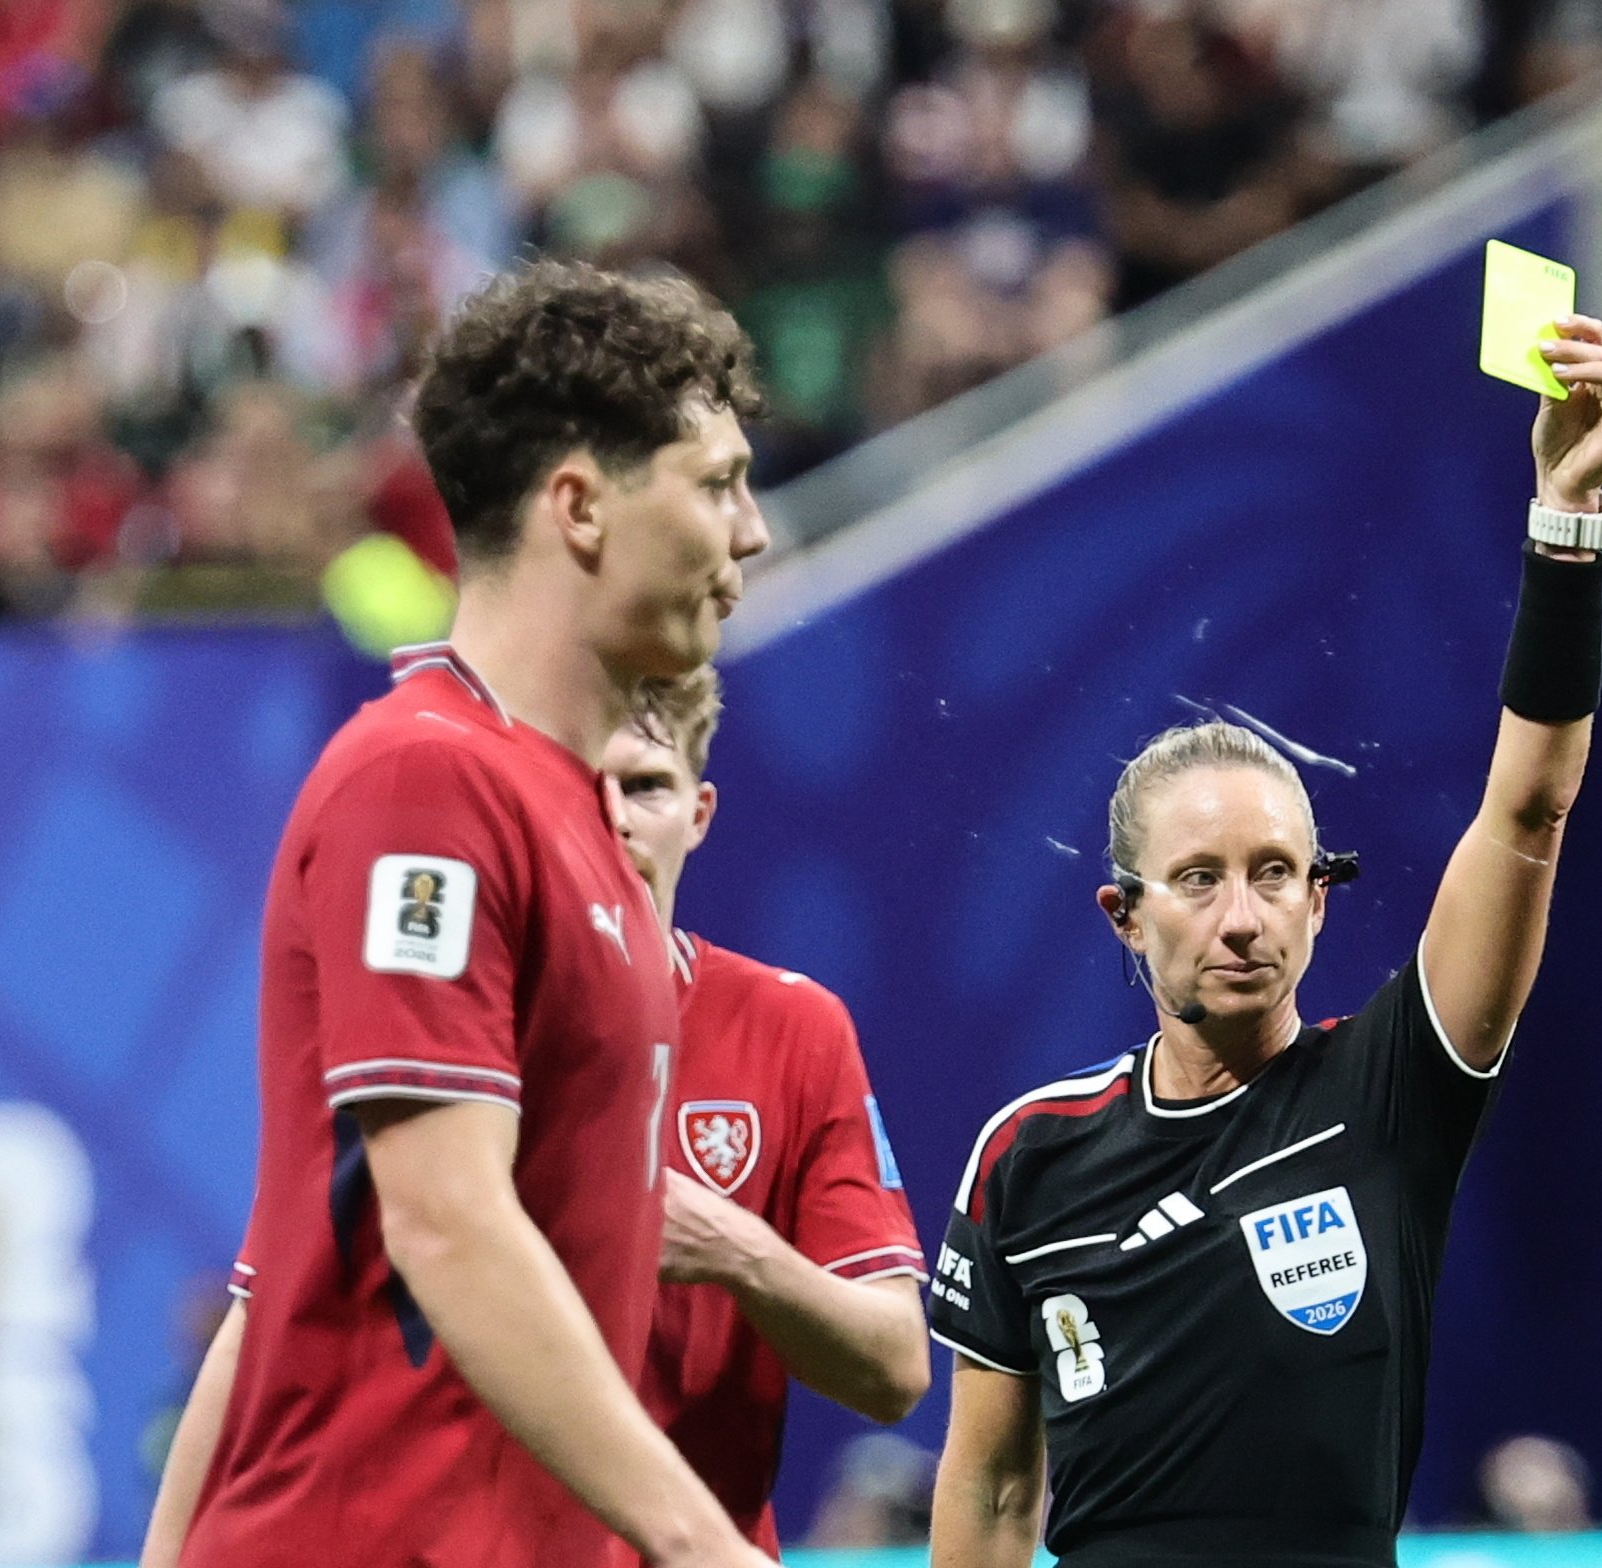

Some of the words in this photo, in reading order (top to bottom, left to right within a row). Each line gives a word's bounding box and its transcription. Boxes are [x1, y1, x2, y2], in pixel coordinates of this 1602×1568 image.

[1254, 1201, 1346, 1251] FIFA
[937, 1241, 972, 1290] IFA
[1270, 1250, 1357, 1288] REFEREE
[1305, 1300, 1347, 1325] 2026
[1073, 1375, 1093, 1390] FIFA
